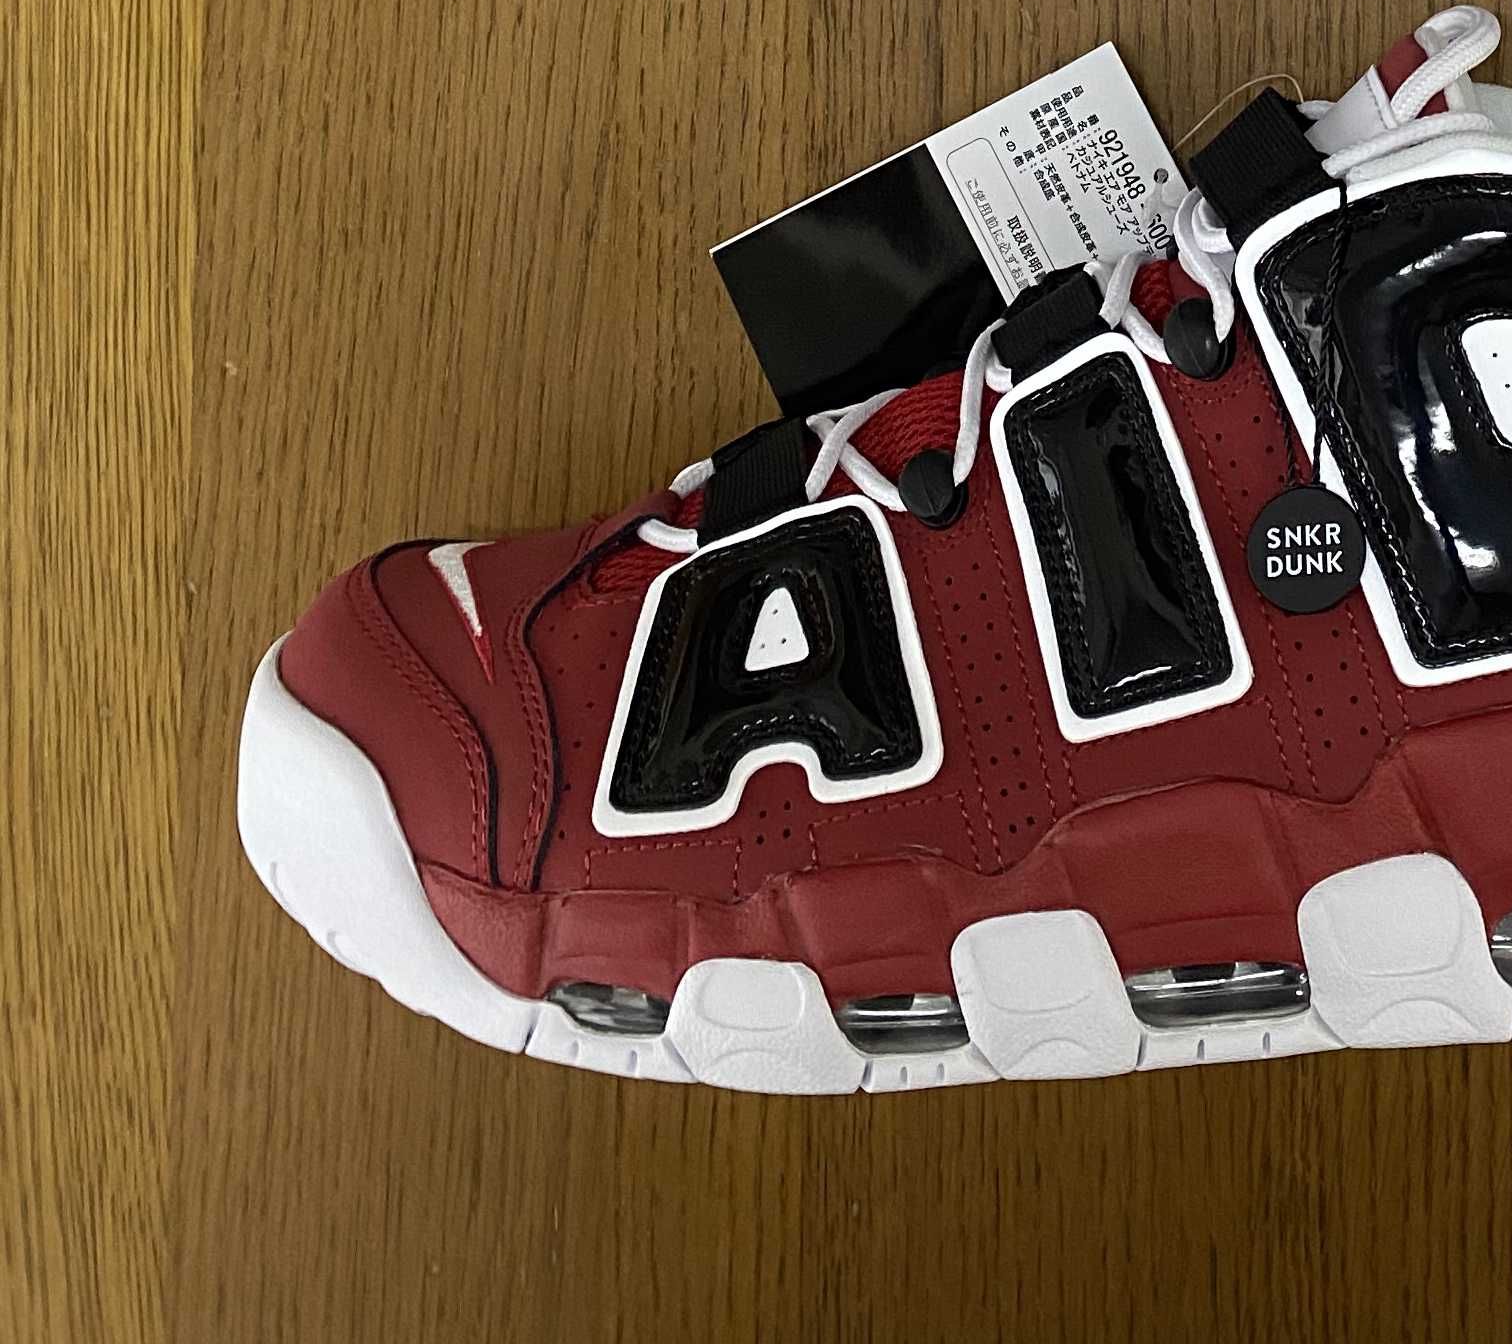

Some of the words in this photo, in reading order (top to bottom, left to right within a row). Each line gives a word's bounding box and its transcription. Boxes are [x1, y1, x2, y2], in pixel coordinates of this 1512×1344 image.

[1097, 128, 1147, 200] 921948
[1266, 522, 1341, 549] SNKR
[1266, 551, 1344, 578] DUNK
